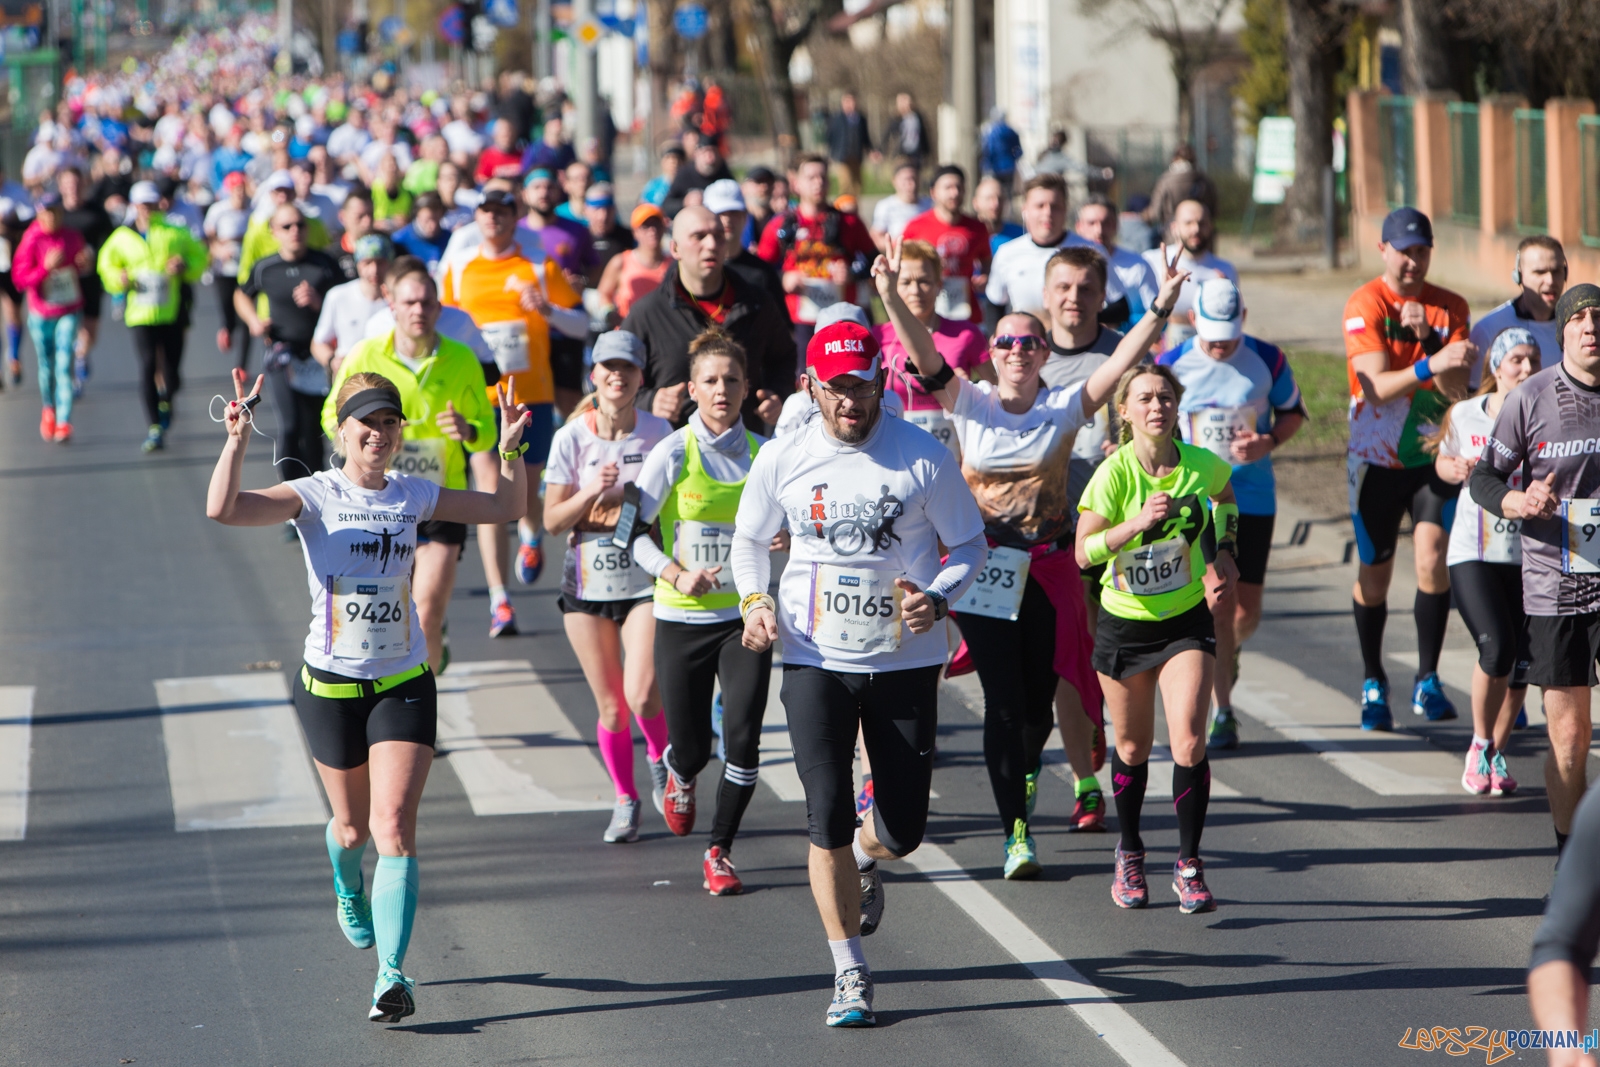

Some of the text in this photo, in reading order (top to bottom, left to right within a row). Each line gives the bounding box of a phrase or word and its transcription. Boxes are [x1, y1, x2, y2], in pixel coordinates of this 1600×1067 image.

[824, 339, 865, 356] POLSKA
[1203, 425, 1243, 442] 933
[392, 454, 440, 474] 4004
[338, 512, 417, 524] SŁYNNI KENIJCZYCY
[1494, 516, 1521, 534] 66
[1582, 523, 1600, 543] 9
[593, 552, 640, 571] 658
[1125, 555, 1183, 586] 10187
[345, 601, 402, 623] 9426
[823, 591, 894, 618] 10165
[844, 618, 870, 626] Mariusz
